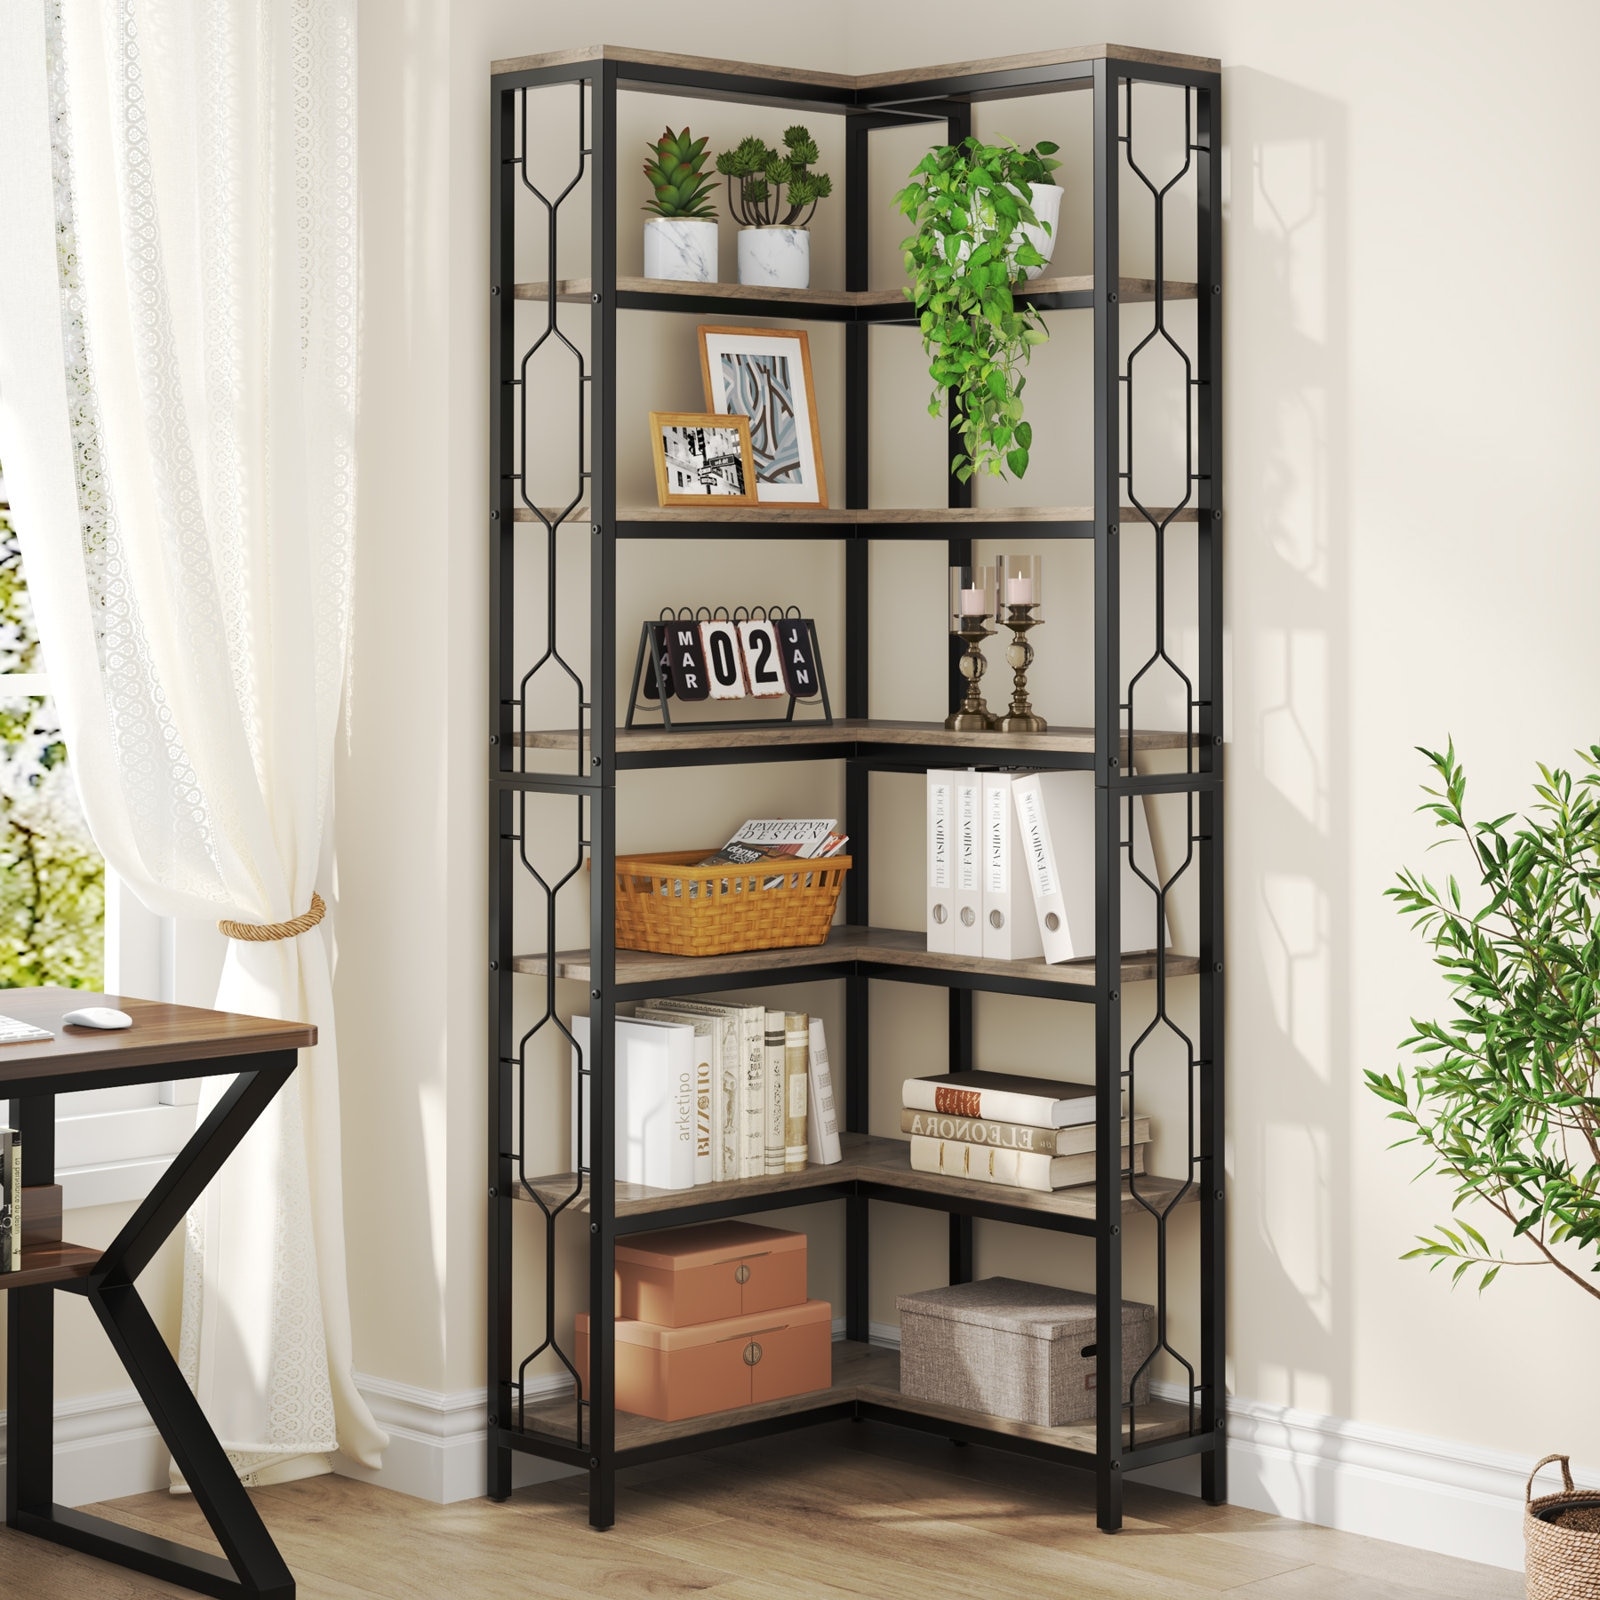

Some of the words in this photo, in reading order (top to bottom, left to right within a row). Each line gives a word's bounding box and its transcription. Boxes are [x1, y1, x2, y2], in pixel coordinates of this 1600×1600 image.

[677, 631, 698, 688] MAR
[788, 628, 809, 685] JAN
[935, 787, 945, 816] BOOK
[963, 788, 973, 818] BOOK
[741, 830, 823, 840] DESIGN
[935, 818, 945, 863] FASHION
[963, 820, 973, 865] FASHION
[992, 822, 1001, 868] FASHION
[1030, 824, 1046, 871] FASHION
[935, 864, 945, 886] THE
[963, 867, 973, 889] THE
[674, 1072, 692, 1141] arketipo
